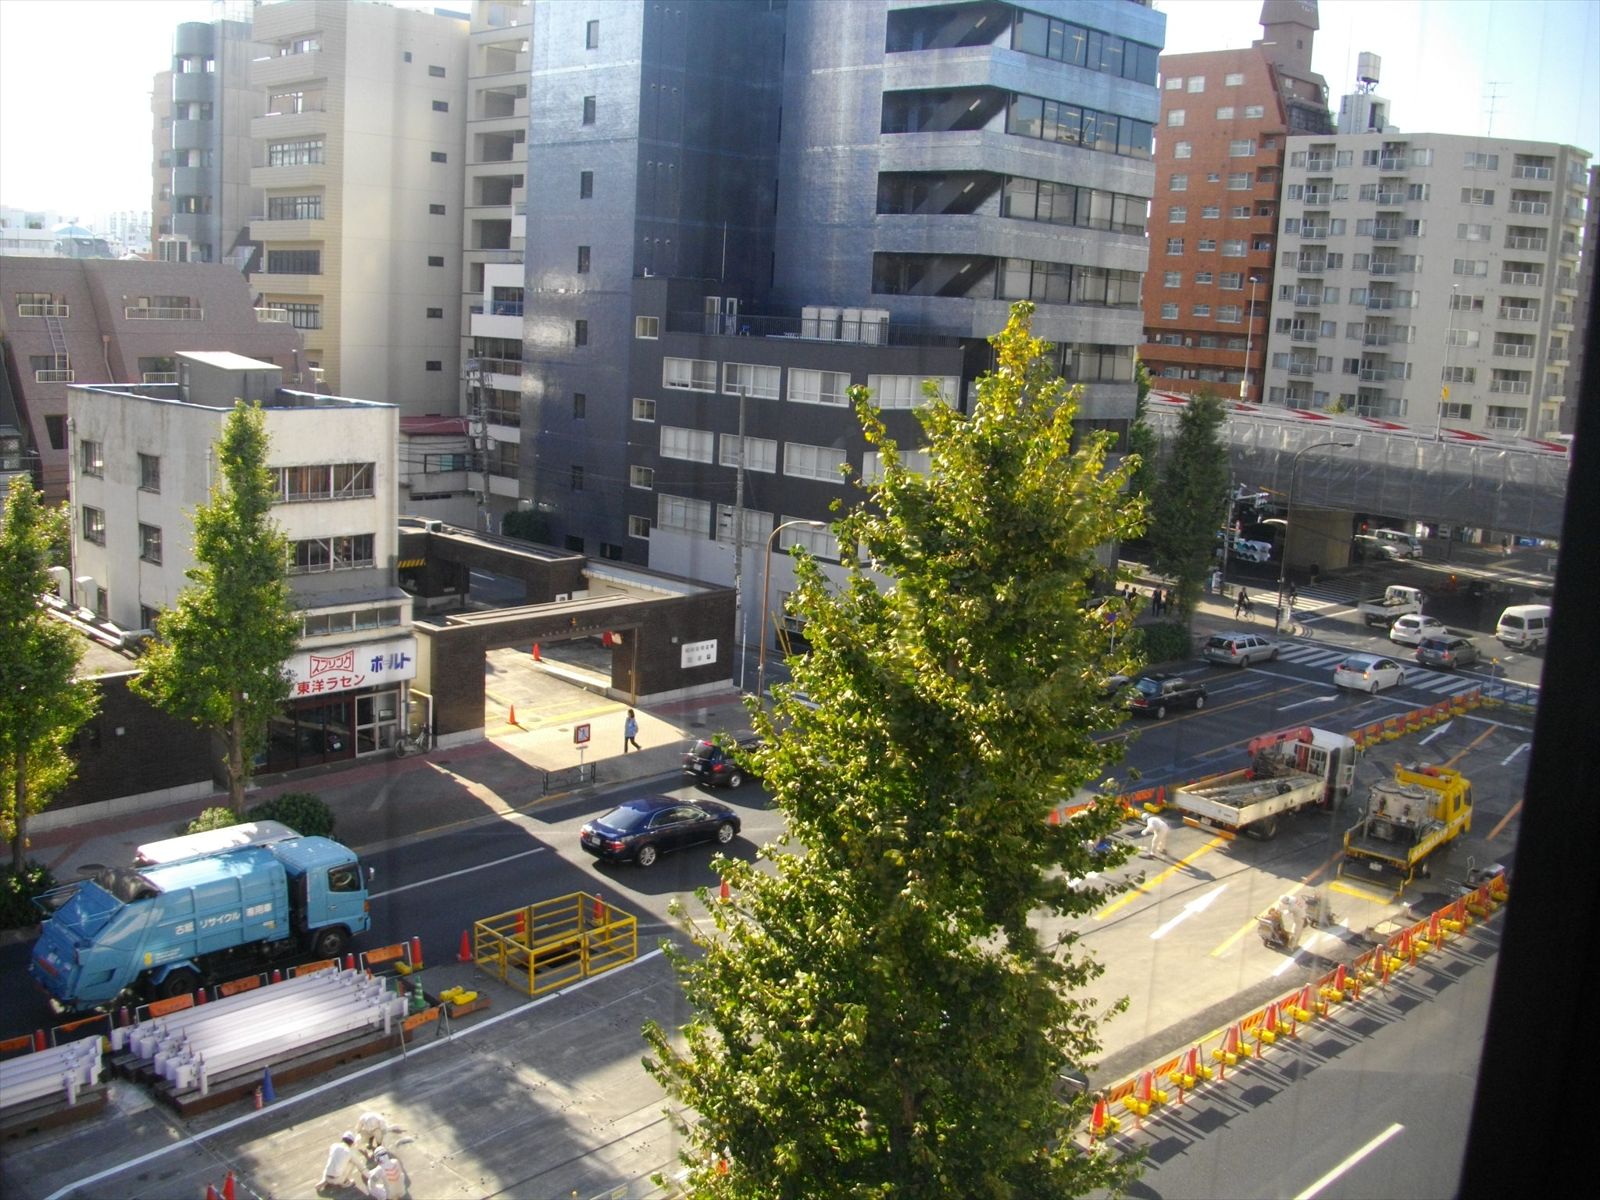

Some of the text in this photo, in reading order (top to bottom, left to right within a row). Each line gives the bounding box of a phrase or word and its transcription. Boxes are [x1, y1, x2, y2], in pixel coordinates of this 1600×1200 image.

[312, 654, 353, 674] スプリング
[297, 674, 366, 695] 東洋ラセン
